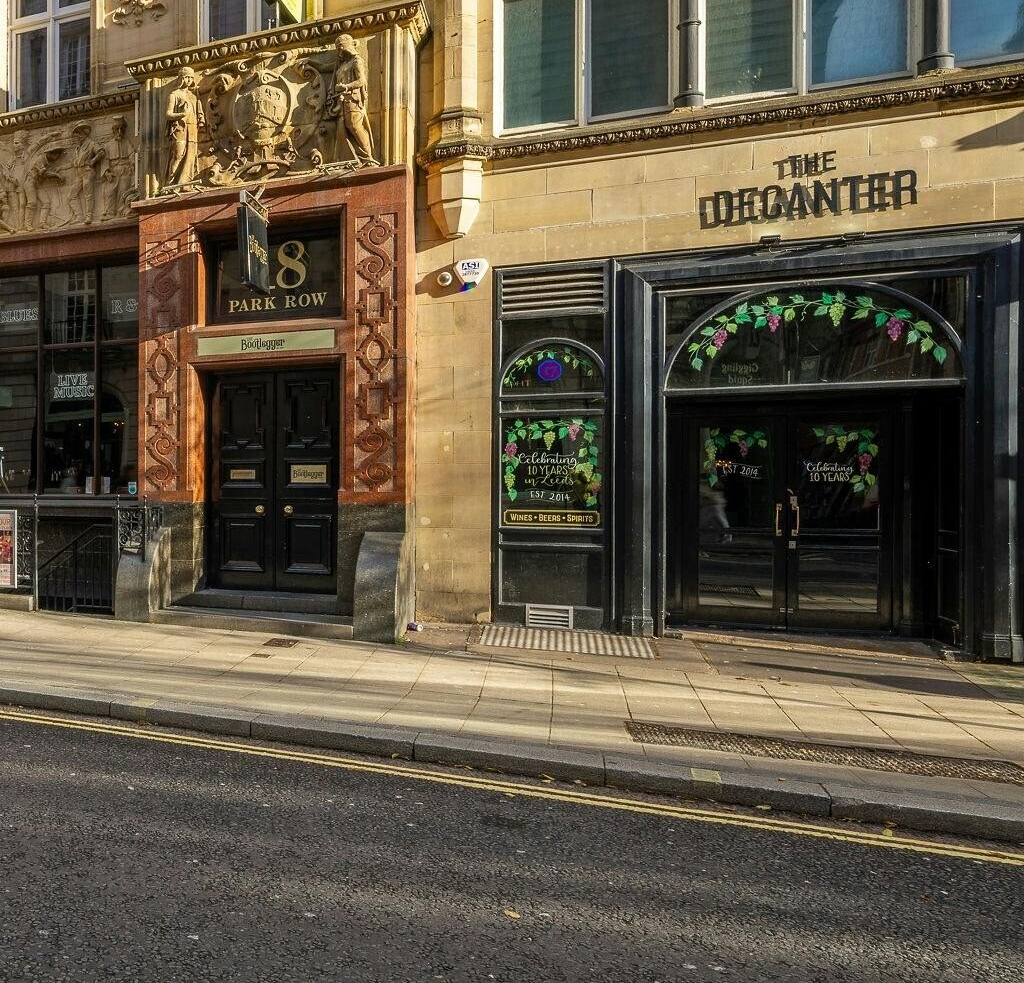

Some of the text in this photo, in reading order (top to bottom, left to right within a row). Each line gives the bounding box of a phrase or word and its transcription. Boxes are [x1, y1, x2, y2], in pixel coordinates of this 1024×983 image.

[784, 150, 837, 178] THE
[713, 169, 918, 227] DECANTER
[270, 240, 307, 289] 8
[111, 298, 138, 314] R &
[228, 292, 328, 314] PARK ROW
[240, 337, 286, 351] Bootlegger
[57, 374, 88, 387] LIVE
[53, 385, 95, 398] MUSIC
[518, 451, 577, 470] Celebrating
[528, 465, 568, 476] 10 YEARS
[739, 467, 759, 477] 2014
[805, 461, 854, 474] Celebrating
[524, 474, 574, 486] in Leeds
[809, 472, 850, 482] 10 YEARS
[530, 491, 571, 502] EST 2014
